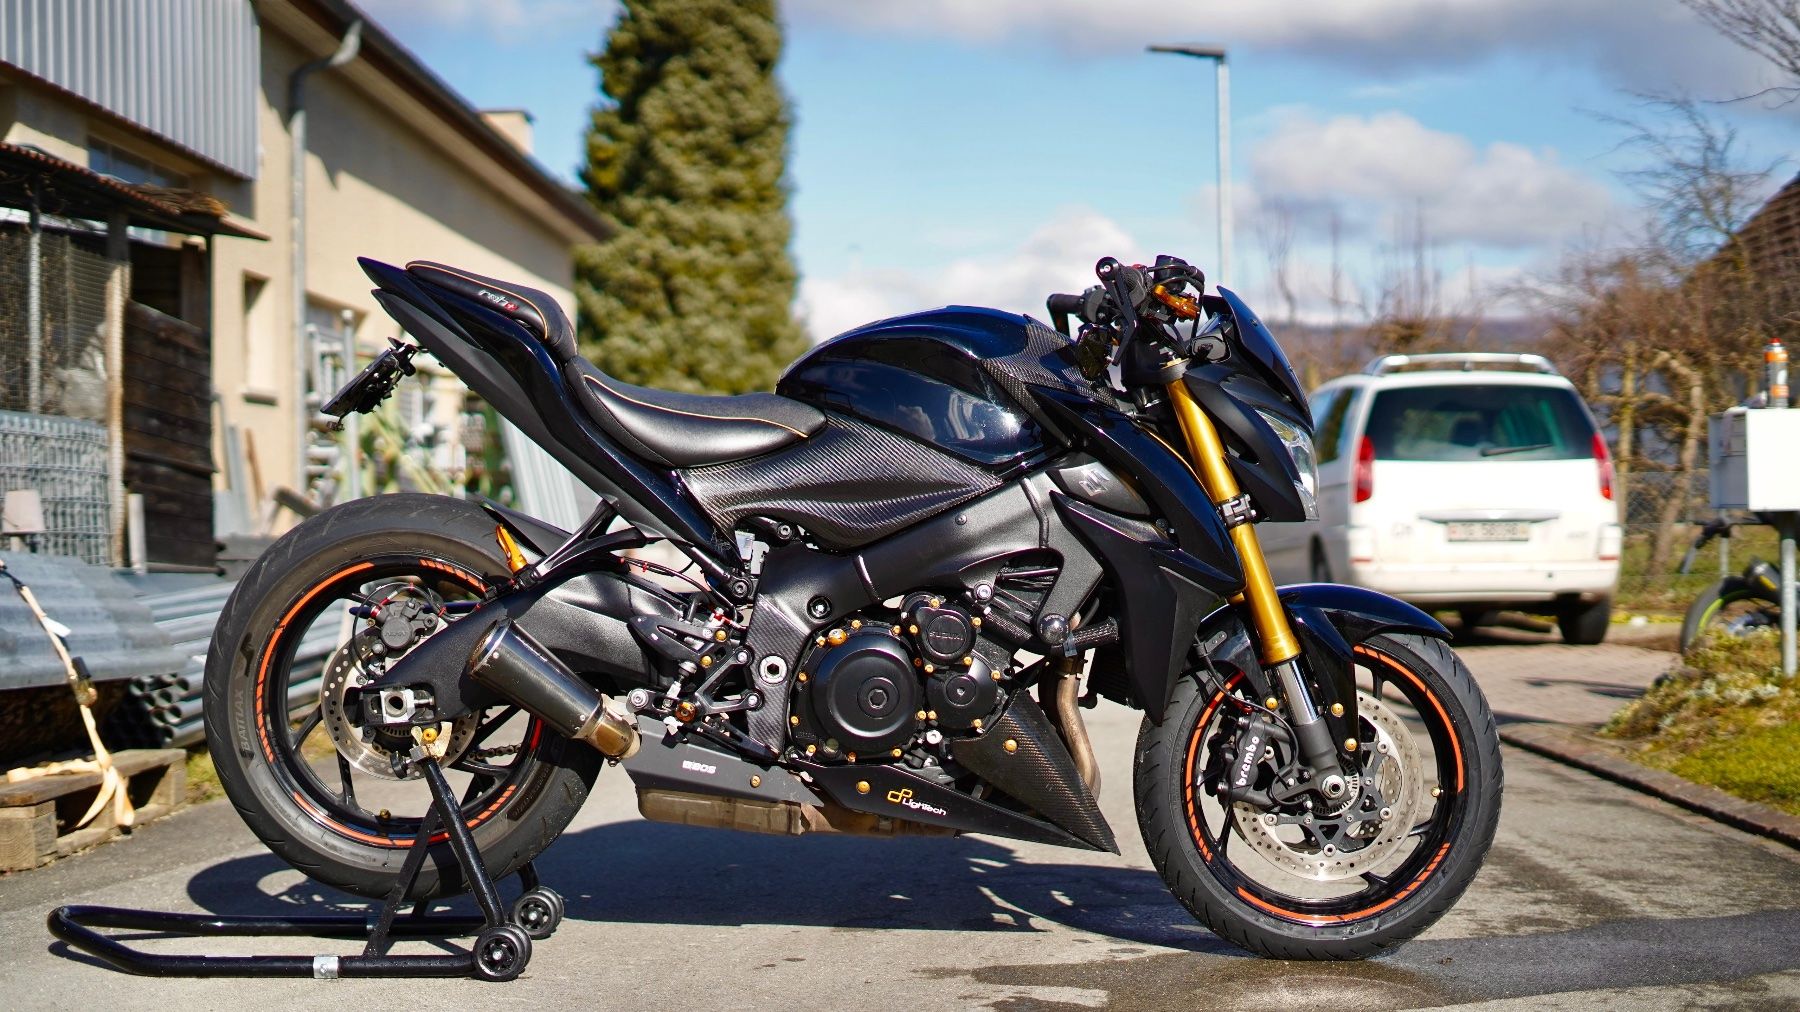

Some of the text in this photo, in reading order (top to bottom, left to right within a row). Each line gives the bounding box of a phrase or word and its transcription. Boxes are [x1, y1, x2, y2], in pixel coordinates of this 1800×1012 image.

[235, 690, 251, 751] BATTLAX
[1236, 736, 1260, 786] brembo
[902, 797, 947, 816] LighTech
